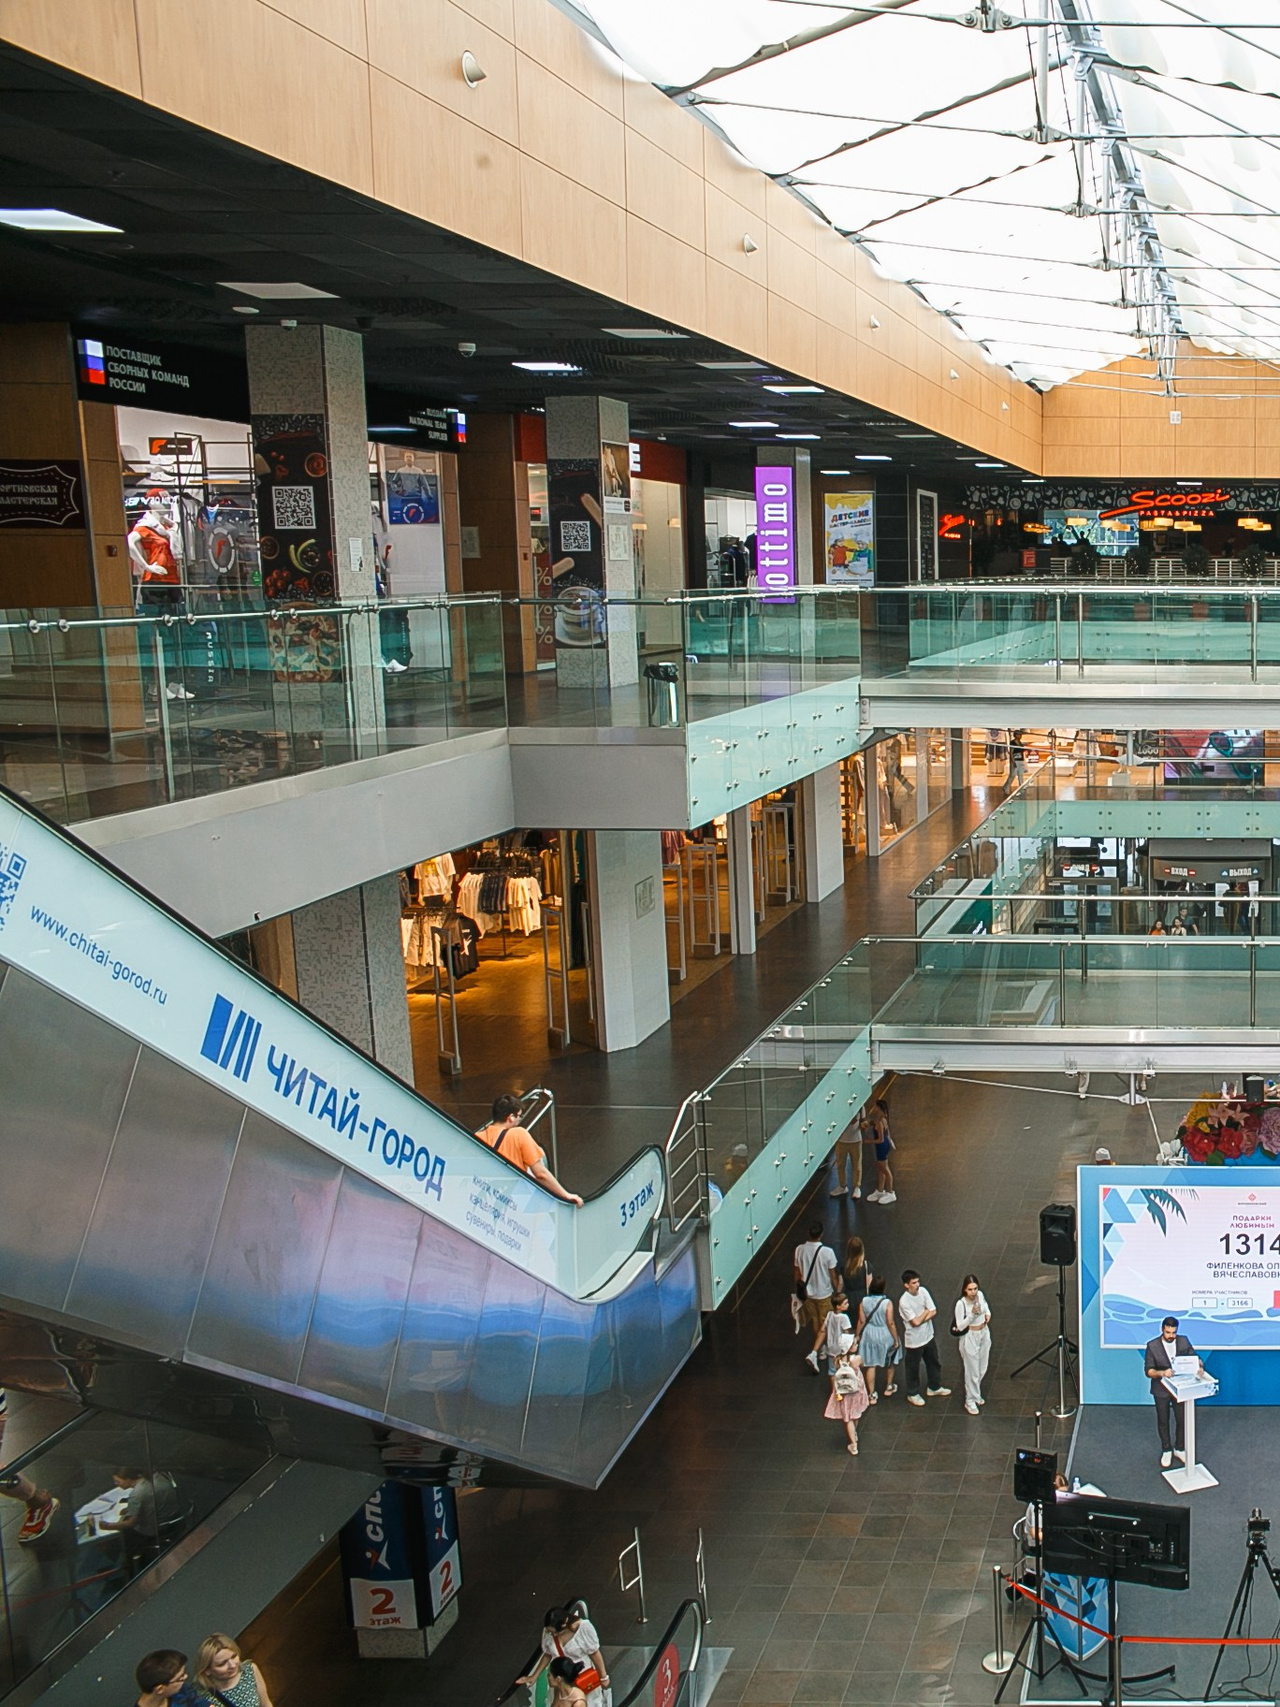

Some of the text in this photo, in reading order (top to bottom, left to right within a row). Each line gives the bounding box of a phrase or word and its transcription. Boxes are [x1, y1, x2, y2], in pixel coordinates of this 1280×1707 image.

[106, 345, 162, 366] ПОСТАВЩИК
[107, 361, 190, 388] СБОРНЫХ КОМАНД
[109, 377, 146, 393] РОССИИ
[831, 509, 869, 523] ДЕТСКИЕ
[1099, 489, 1230, 519] Scoozi
[205, 631, 215, 683] RUSSIA
[1171, 867, 1188, 876] ВХОД
[1229, 867, 1252, 876] ВЫХОД
[30, 905, 168, 1005] www.chitai-gorod.ru
[267, 1044, 446, 1202] ЧИТАЙ-ГОРОД
[620, 1179, 654, 1227] 3 этаж
[1206, 1262, 1264, 1270] ФИЛЕНКОВА
[440, 1560, 453, 1596] 2
[369, 1588, 397, 1615] 2
[369, 1616, 402, 1626] этаж
